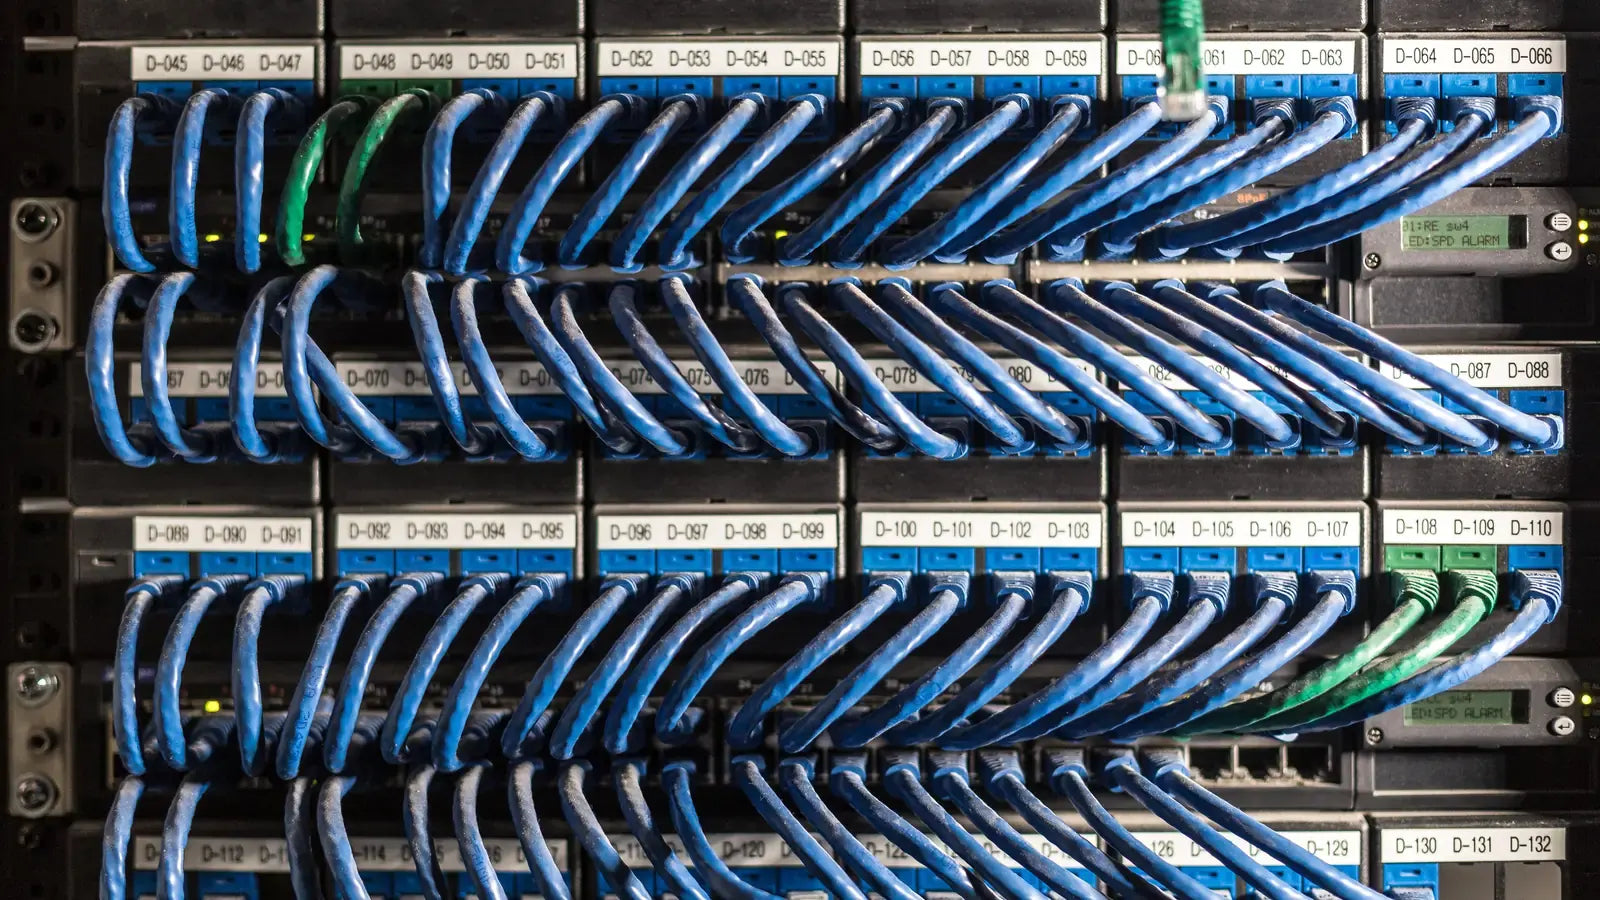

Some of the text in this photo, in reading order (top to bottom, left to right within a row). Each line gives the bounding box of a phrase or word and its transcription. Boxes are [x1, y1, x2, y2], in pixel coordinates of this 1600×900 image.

[146, 54, 301, 72] D-045 D-046 D-047
[354, 53, 565, 71] D-048 D-049 D-050 D-051
[612, 50, 826, 67] D-052 D-053 D-054 D-055
[873, 50, 1087, 67] D-056 D-057 D-058 D-059
[1128, 49, 1160, 66] D-06
[1244, 49, 1285, 66] D-062
[1302, 49, 1343, 66] D-063
[1396, 47, 1552, 64] D-064 D-065 D-066
[1446, 220, 1469, 231] sw4
[1405, 237, 1500, 248] ED:SPD ALARM
[201, 370, 229, 388] D-0
[257, 371, 283, 388] D-0
[348, 369, 390, 387] D-070
[405, 370, 429, 387] D-0
[876, 367, 917, 384] D-078
[1008, 366, 1032, 383] 080
[1148, 364, 1172, 381] 082
[1451, 362, 1549, 379] D-087 D-088
[148, 526, 302, 543] D-089 D-090 D-091
[349, 522, 564, 540] D-092 D-093 D-094 D-095
[611, 522, 824, 541] D-096 D-097 D-098 D-099
[876, 520, 1089, 538] D-100 D-101 D-102 D-103
[1134, 521, 1349, 538] D-104 D-105 D-106 D-107
[1396, 519, 1552, 536] D-108 D-109 D-110
[1408, 707, 1504, 719] ED:SPD ALARM
[354, 844, 385, 861] -114
[722, 839, 765, 858] D-120
[1307, 839, 1349, 857] D-129
[1396, 836, 1552, 854] D-130 D-131 D-132
[202, 845, 244, 863] D-112
